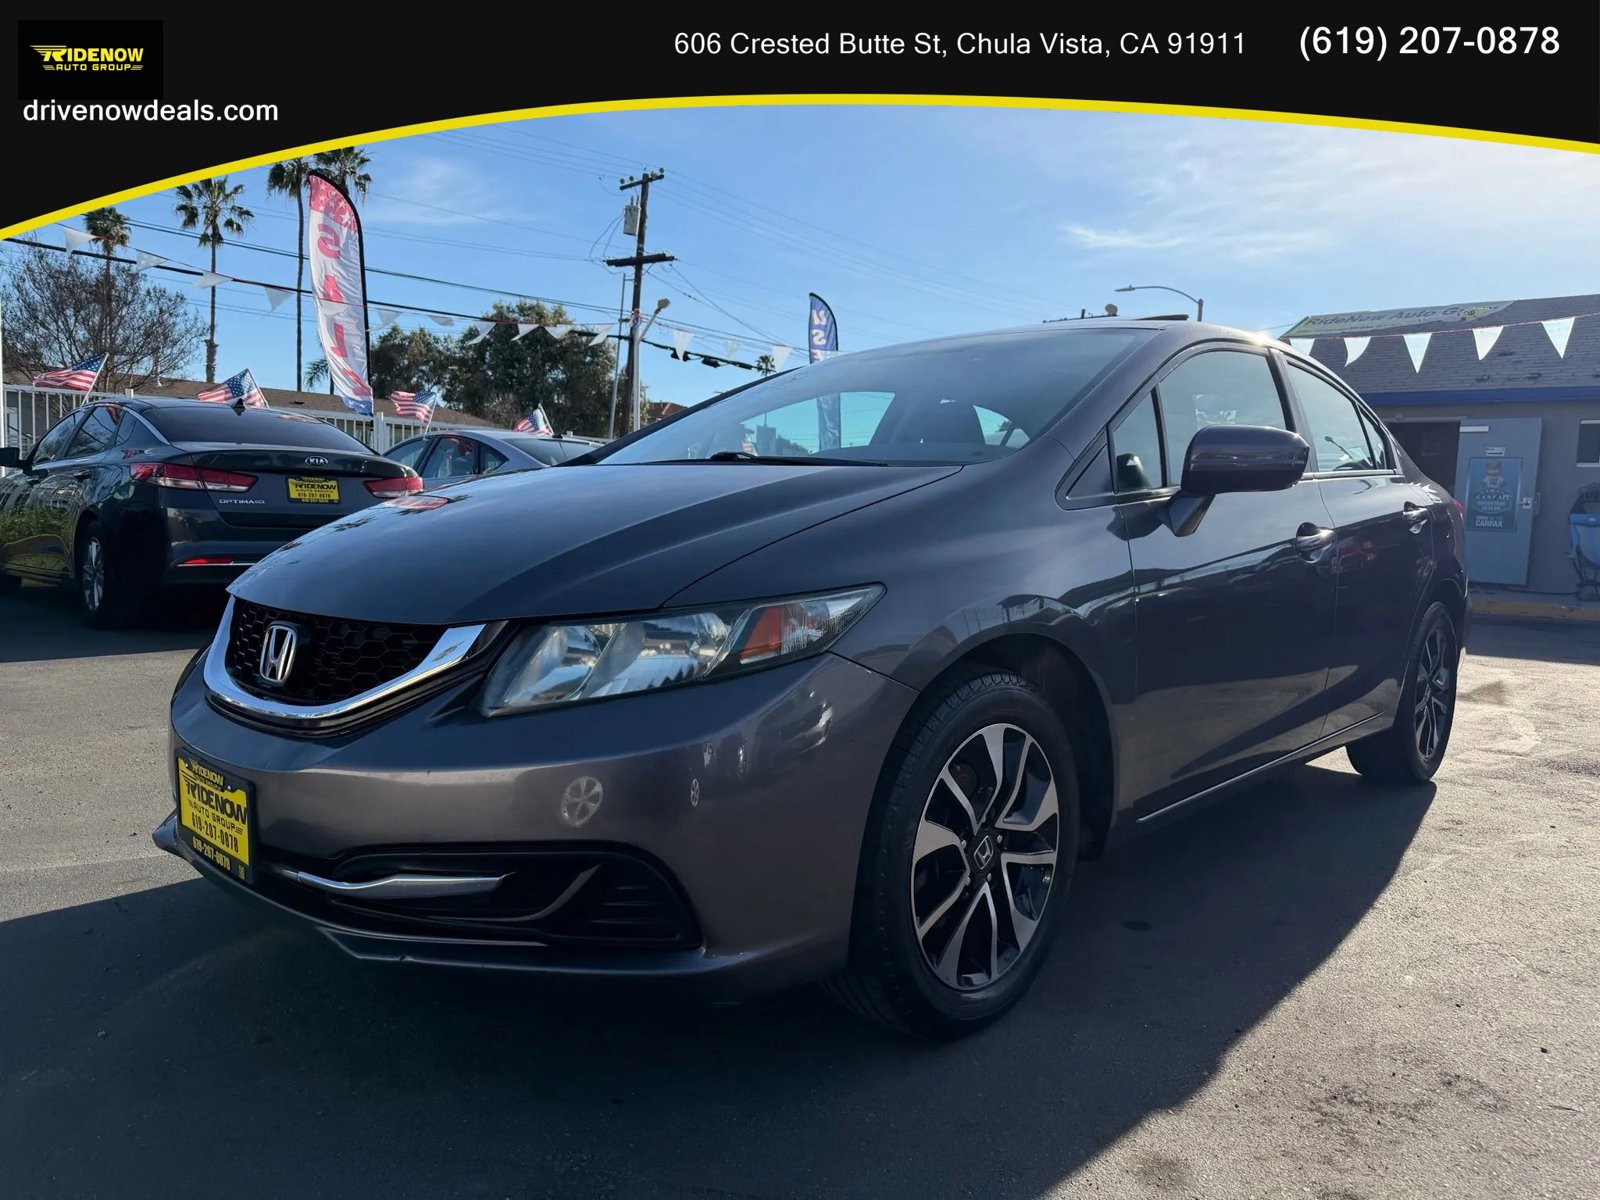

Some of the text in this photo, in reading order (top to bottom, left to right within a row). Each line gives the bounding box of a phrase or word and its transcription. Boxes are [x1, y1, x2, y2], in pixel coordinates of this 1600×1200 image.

[1306, 312, 1391, 326] RideNow
[1391, 309, 1437, 320] Auto
[1475, 519, 1503, 528] CARFAX
[182, 770, 247, 825] RIDENOW
[193, 802, 237, 832] AUTO GROUP
[191, 811, 239, 854] 619-207-0878
